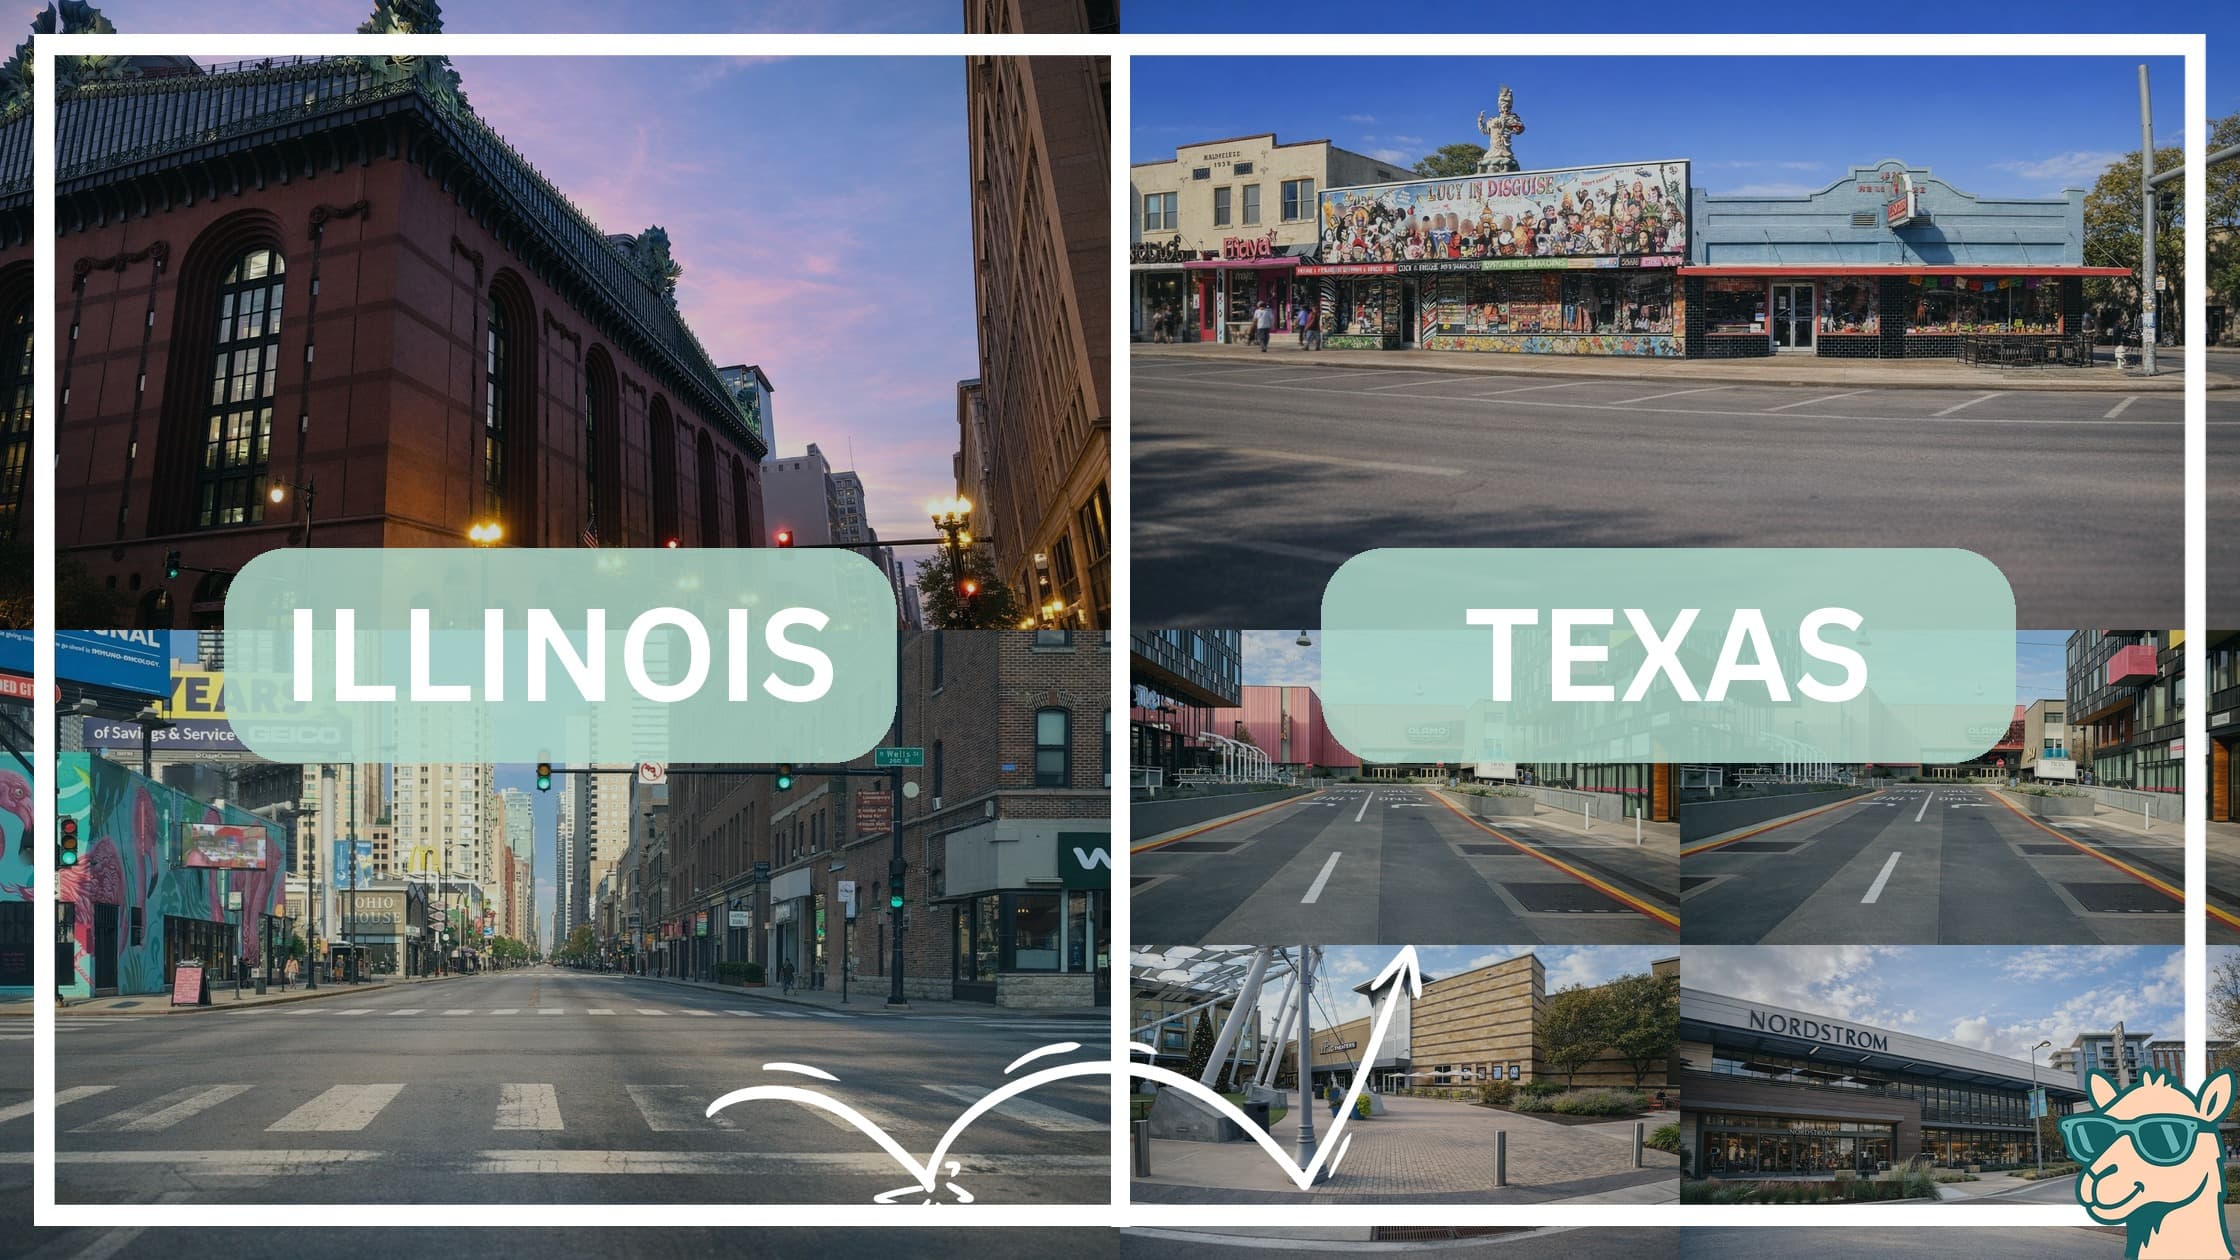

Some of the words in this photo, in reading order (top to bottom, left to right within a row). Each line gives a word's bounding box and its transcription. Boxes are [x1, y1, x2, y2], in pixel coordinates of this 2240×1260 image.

[1426, 183, 1463, 201] LUCY
[1468, 181, 1483, 200] IN
[1487, 176, 1555, 198] DISGUISE
[94, 726, 110, 740] of
[112, 726, 166, 743] Savigs
[168, 727, 181, 741] &
[183, 727, 235, 742] Service
[886, 750, 911, 758] Wells
[355, 896, 394, 910] OHIO
[1749, 1009, 1888, 1052] NORDSTROM
